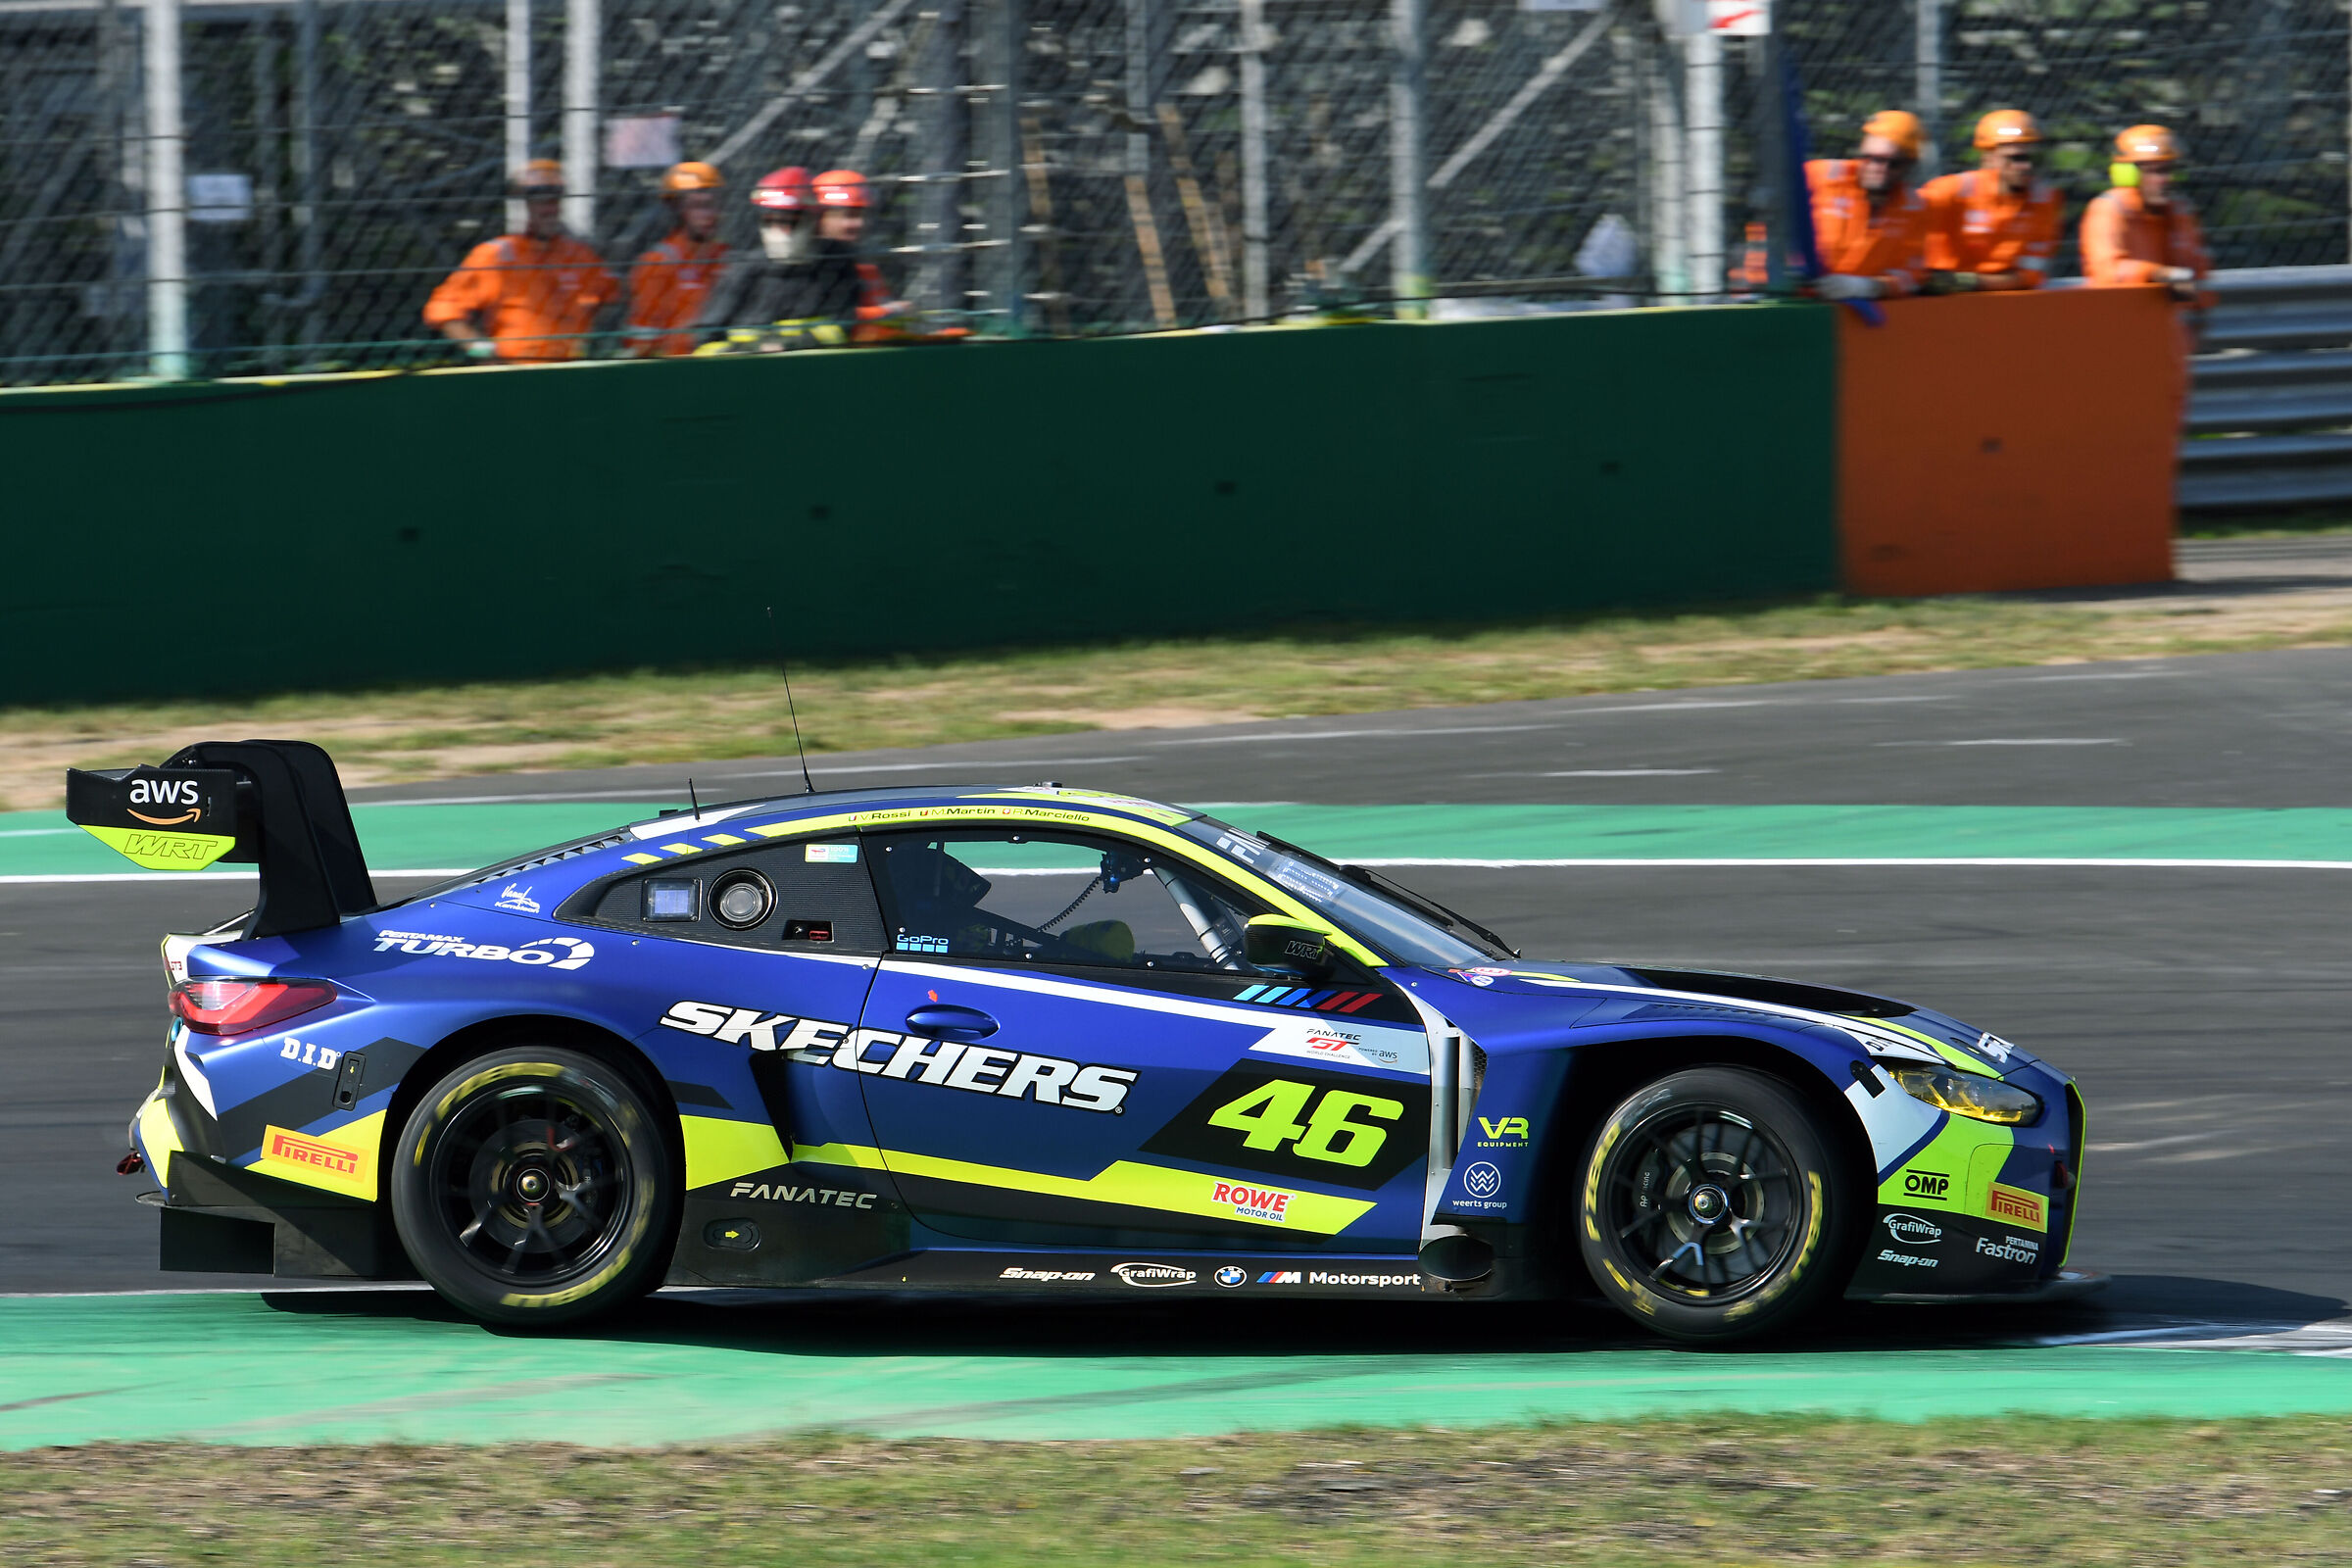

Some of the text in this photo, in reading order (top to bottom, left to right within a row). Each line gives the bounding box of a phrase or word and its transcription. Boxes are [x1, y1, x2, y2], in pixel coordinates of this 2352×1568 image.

[129, 778, 198, 805] aws
[860, 806, 1090, 821] V.Rossi M.Martin R.Marciello
[123, 834, 218, 859] WRT
[378, 930, 466, 943] PERTAMAX
[897, 934, 949, 945] GoPro
[373, 937, 555, 965] TURBO
[1284, 940, 1323, 959] WRT
[1306, 1028, 1361, 1041] FANATEC
[661, 1001, 1141, 1112] SKECHERS
[1379, 1050, 1397, 1059] aws
[1207, 1079, 1404, 1167] 46
[1478, 1117, 1529, 1139] VR
[271, 1134, 359, 1174] PIRELLI
[1904, 1174, 1949, 1196] OMP
[730, 1181, 877, 1210] FANATEC
[1213, 1182, 1290, 1212] ROWE
[1484, 1200, 1507, 1209] group
[1236, 1206, 1283, 1221] MOTOR OIL
[1991, 1190, 2039, 1223] PIRELLI
[1887, 1219, 1941, 1238] GrafiWrap
[1976, 1237, 2036, 1264] Fastron
[2005, 1235, 2038, 1250] PERTAMINA
[1877, 1249, 1938, 1267] Snap-on
[1000, 1267, 1096, 1282] Snap-on
[1118, 1268, 1197, 1281] GrafiWrap
[1309, 1271, 1421, 1288] Motorsport
